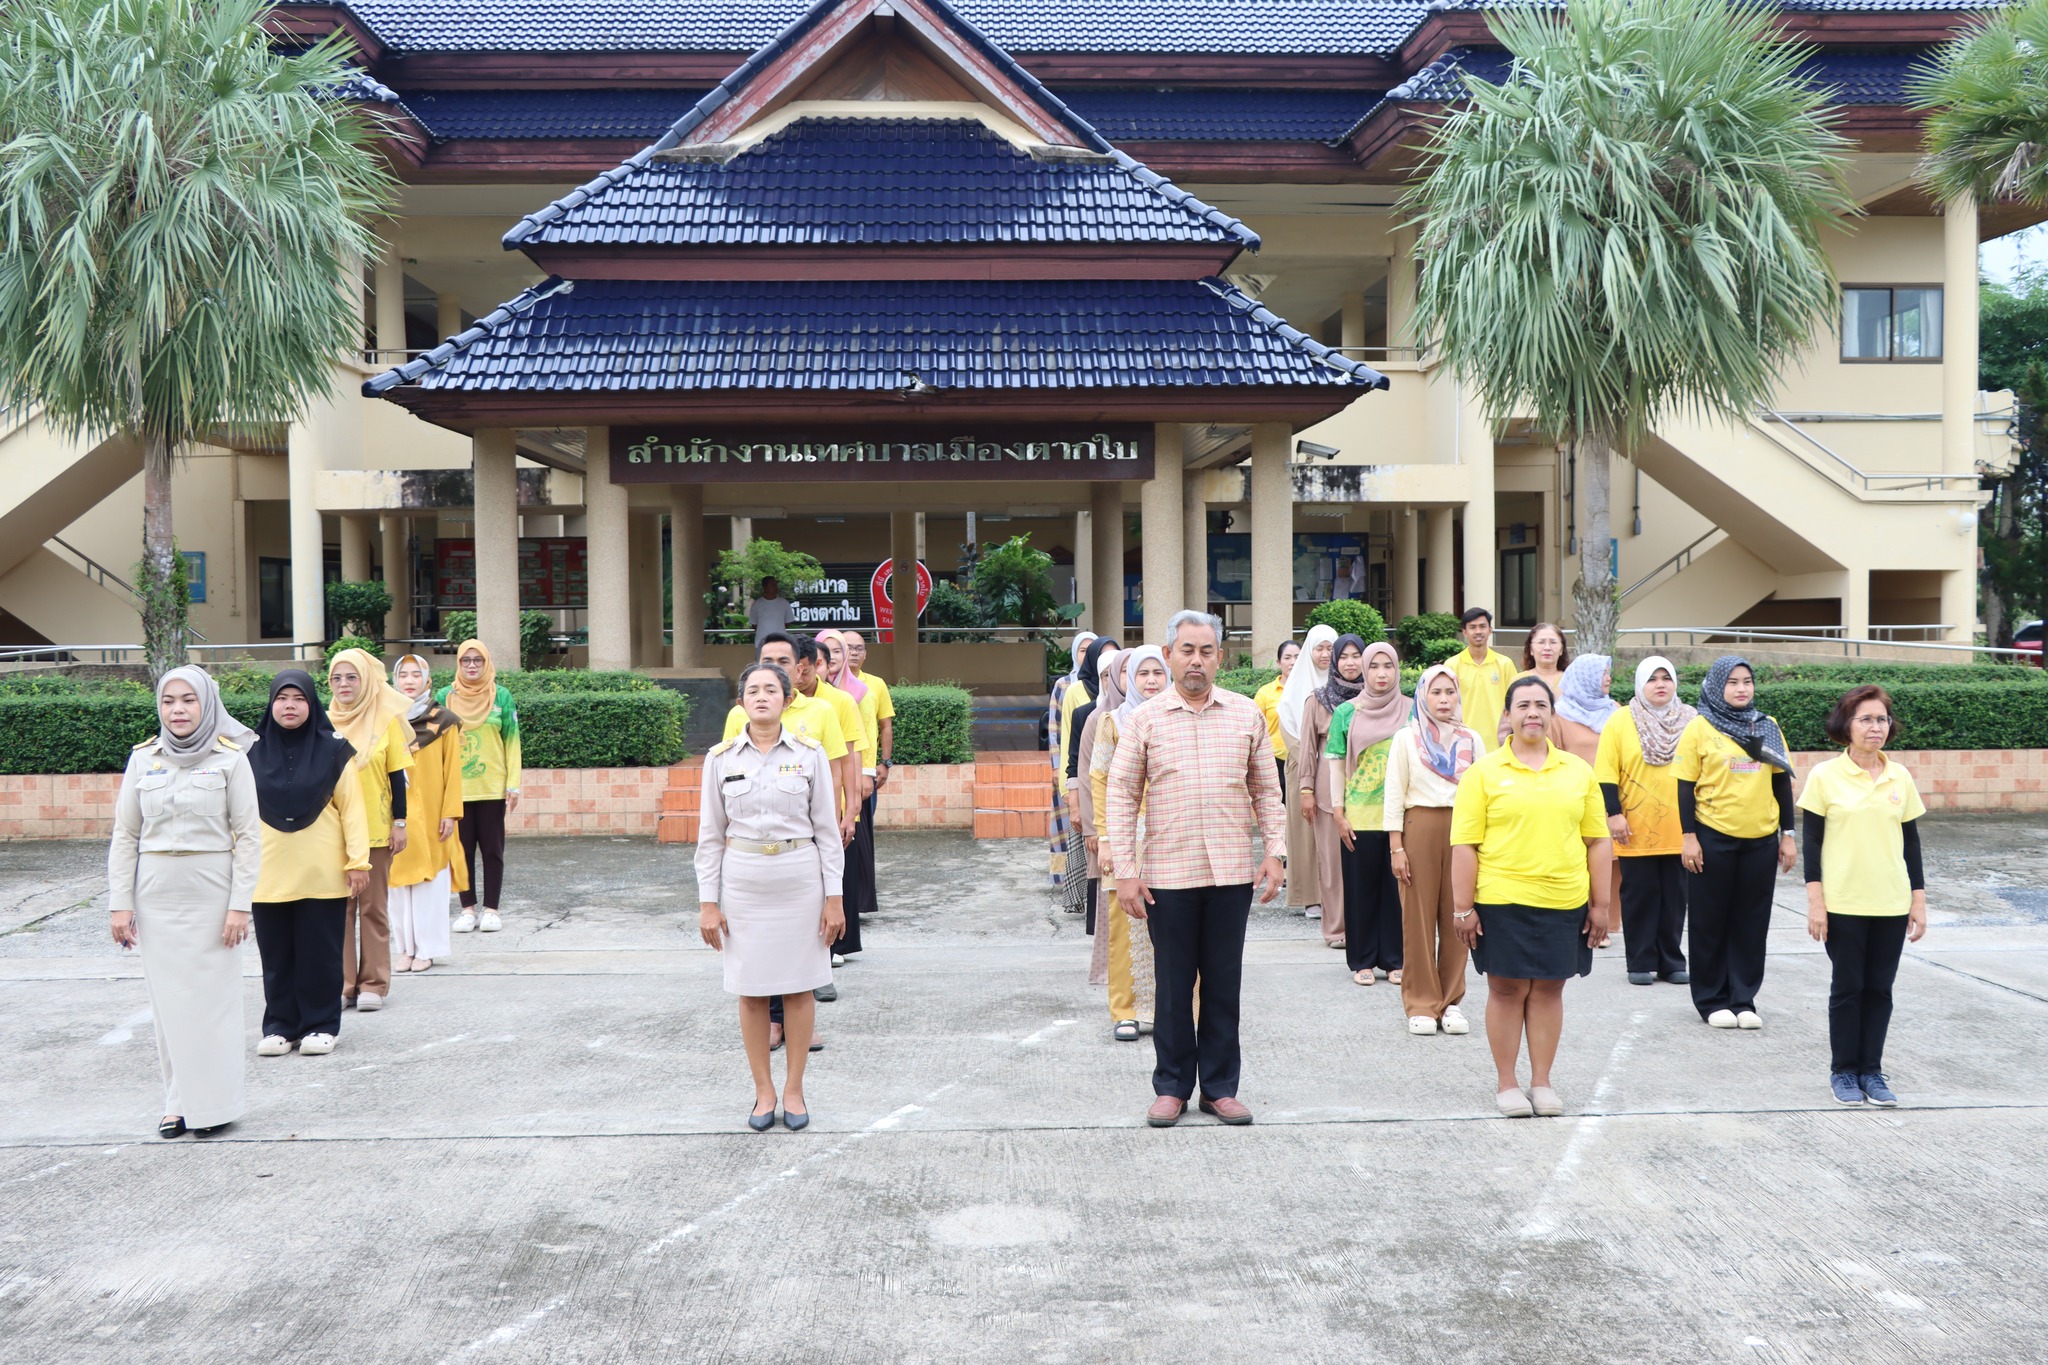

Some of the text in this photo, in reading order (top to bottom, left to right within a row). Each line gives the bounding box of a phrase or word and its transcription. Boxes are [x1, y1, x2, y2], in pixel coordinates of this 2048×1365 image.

[627, 433, 1138, 463] สำนักงานเทศบาลเมืองตากใบ
[790, 599, 861, 622] มืองตากใบ
